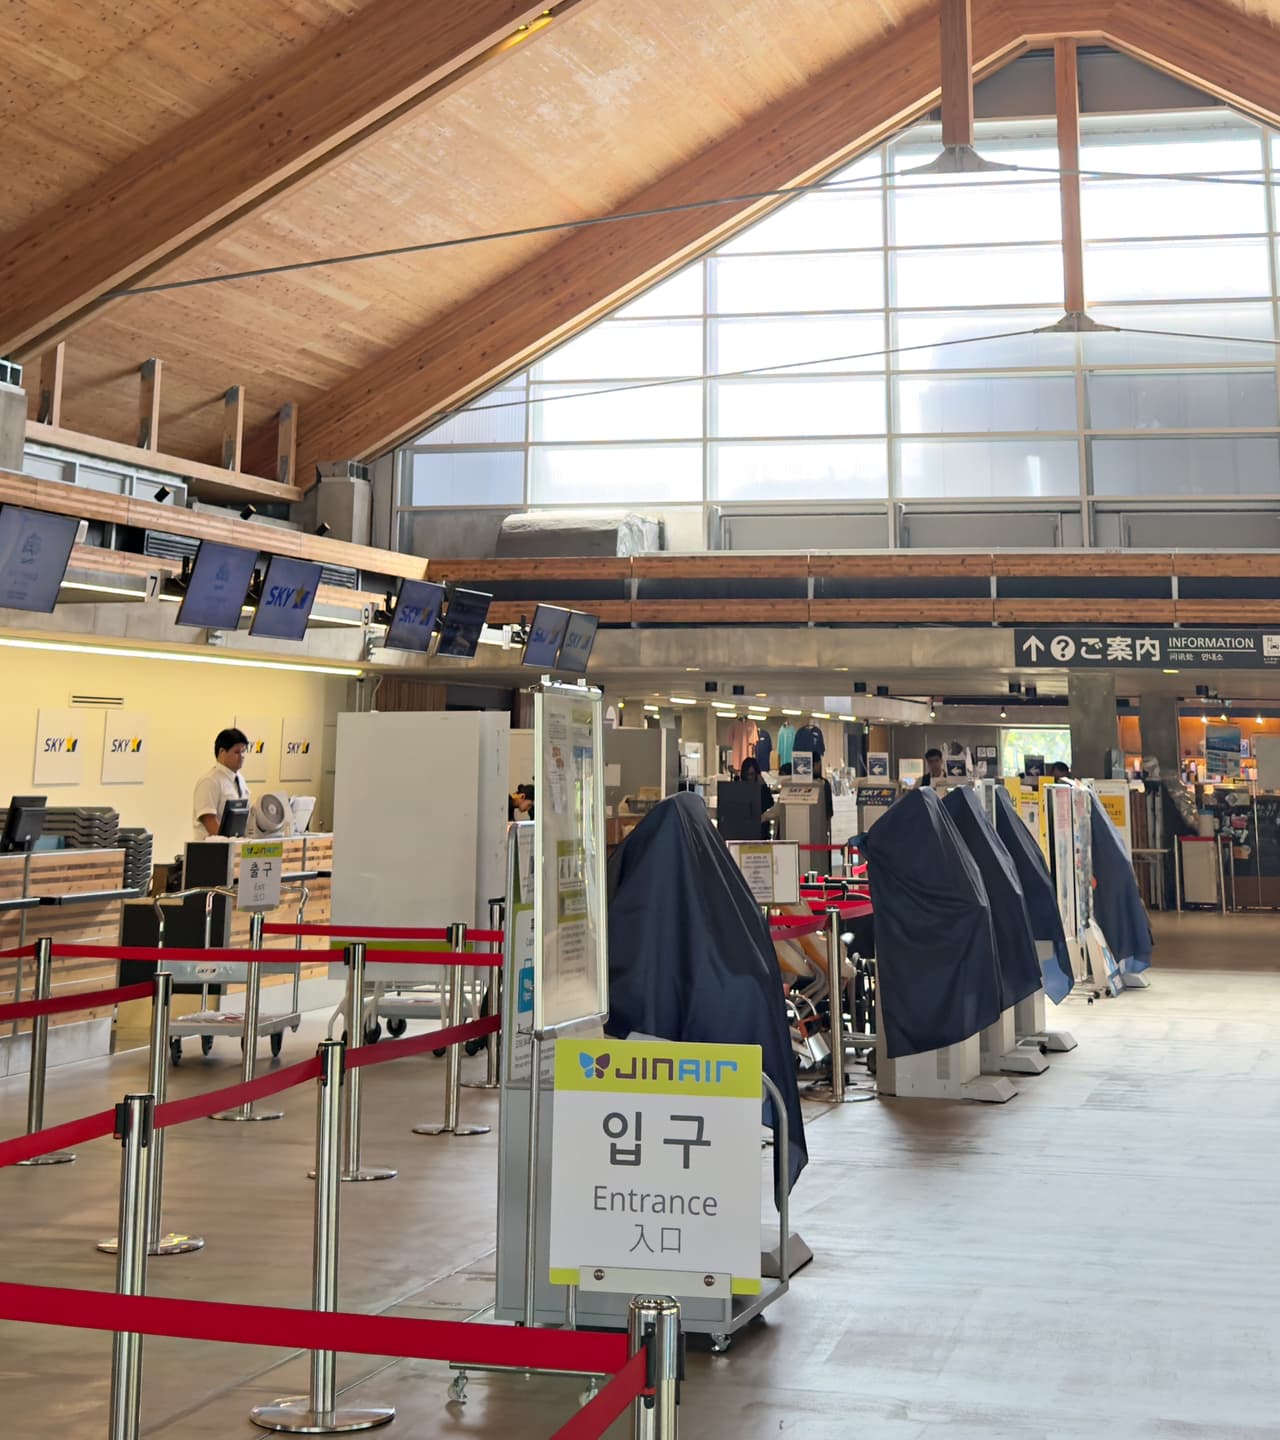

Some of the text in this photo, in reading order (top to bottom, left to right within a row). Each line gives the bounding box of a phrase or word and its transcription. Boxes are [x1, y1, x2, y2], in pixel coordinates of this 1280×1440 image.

[149, 575, 157, 597] 7
[265, 585, 296, 608] SKY
[364, 608, 370, 625] 9
[1080, 635, 1160, 661] ご案内
[1169, 637, 1255, 648] INFORMATION
[43, 737, 65, 752] SKY
[111, 738, 130, 752] SKY
[286, 742, 300, 754] SKY
[593, 1186, 718, 1216] Entrance
[629, 1224, 682, 1254] 入口
